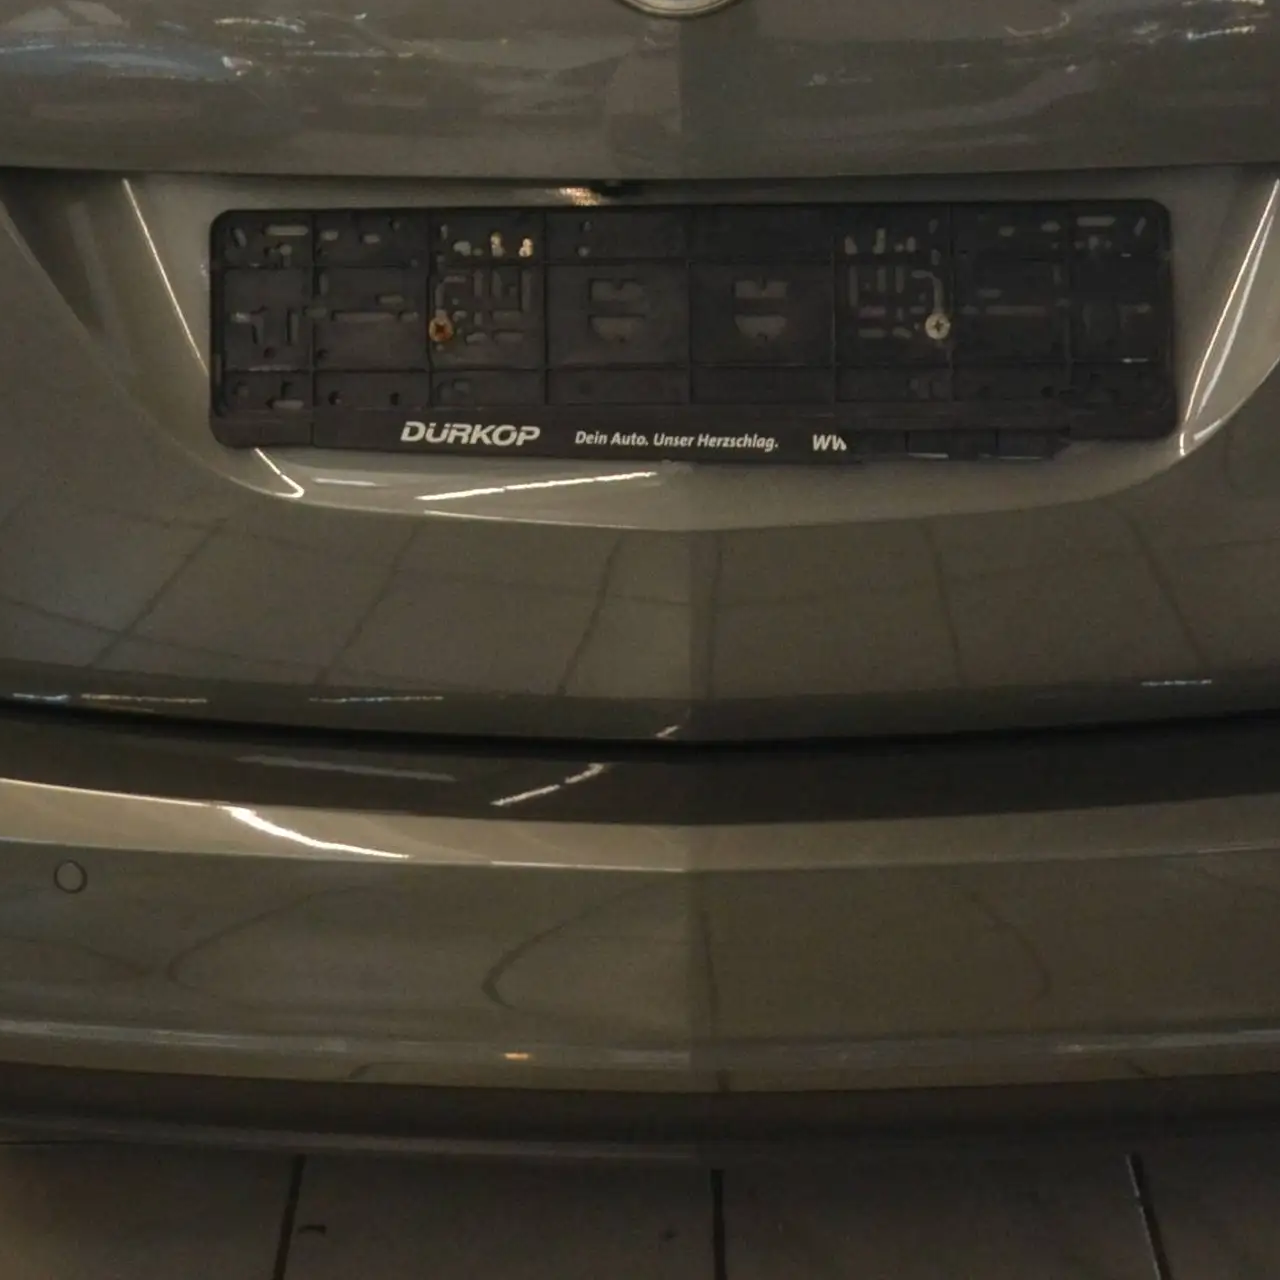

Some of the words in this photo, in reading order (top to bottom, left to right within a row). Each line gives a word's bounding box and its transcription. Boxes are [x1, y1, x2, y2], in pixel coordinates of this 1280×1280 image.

[400, 421, 541, 446] DÜRKOP
[575, 431, 608, 445] Dein
[610, 432, 649, 446] Auto.
[653, 433, 694, 447] Unser
[696, 433, 779, 452] Herzschlag.
